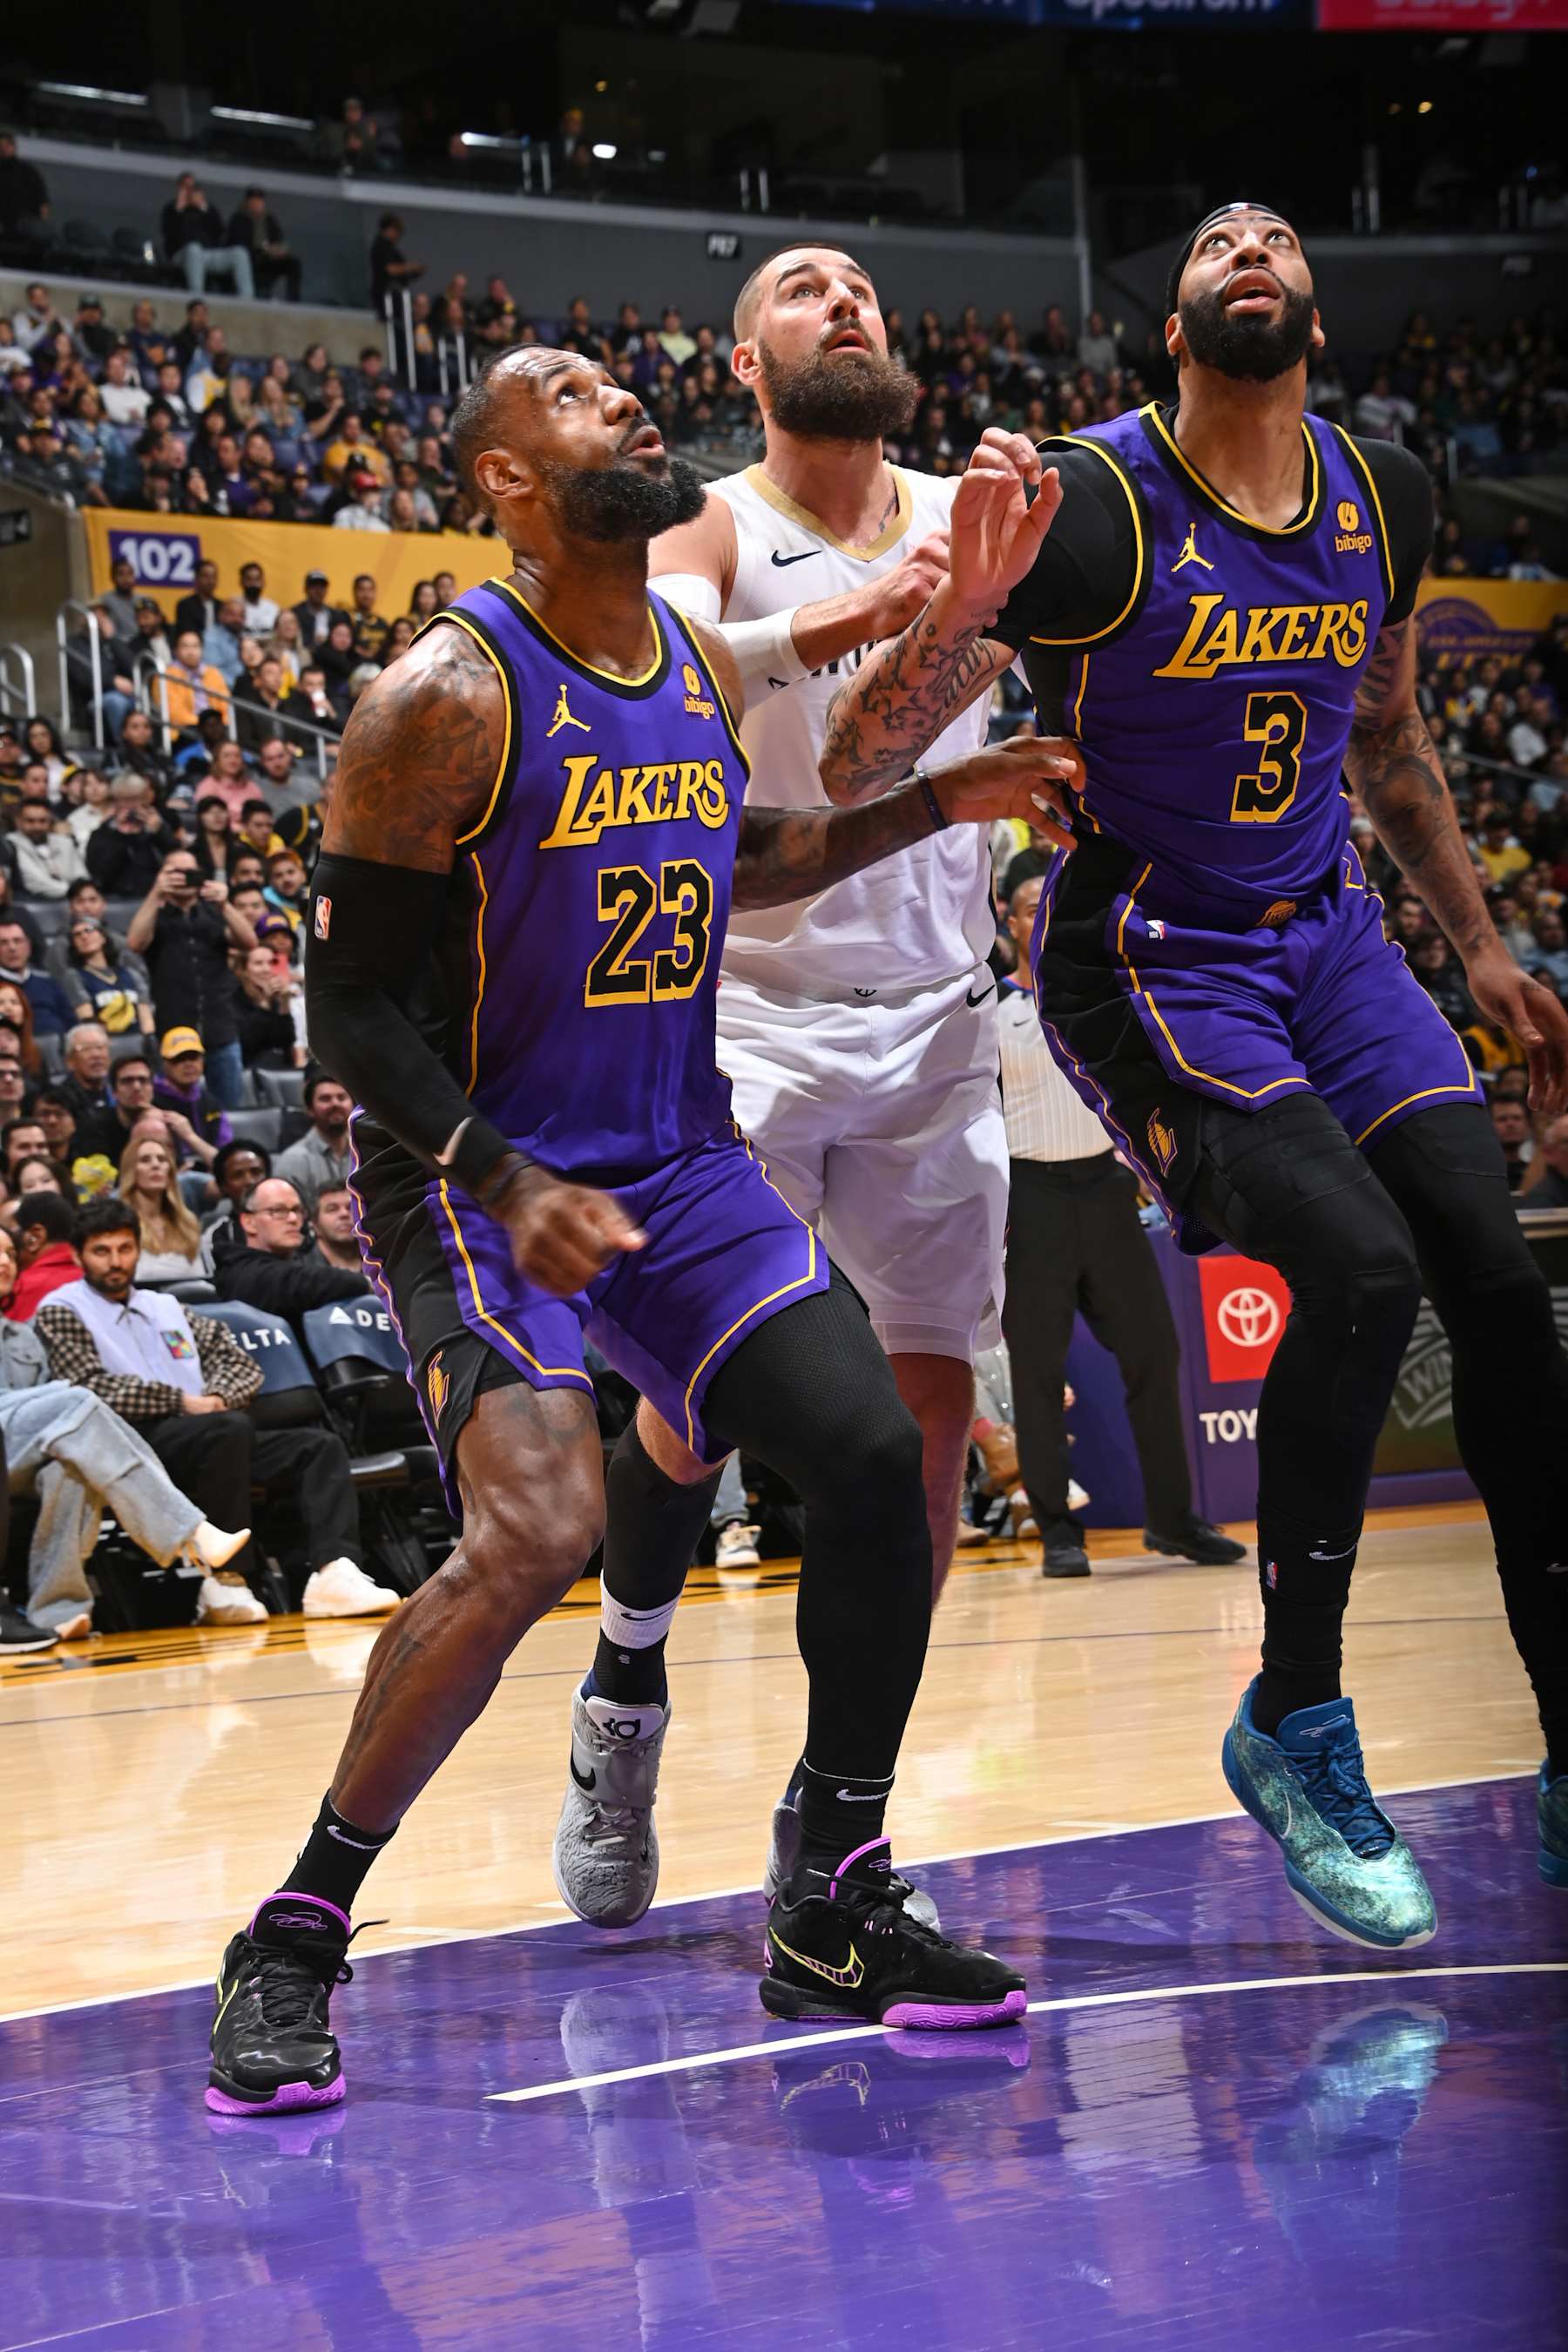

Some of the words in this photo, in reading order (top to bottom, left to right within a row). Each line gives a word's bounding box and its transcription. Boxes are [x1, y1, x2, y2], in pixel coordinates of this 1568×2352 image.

[119, 537, 195, 581] 102
[1335, 534, 1372, 554] bibigo
[1152, 593, 1369, 679] LAKERS
[683, 695, 715, 720] bibigo
[1229, 691, 1308, 823] 3
[537, 755, 730, 850] LAKERS
[584, 858, 713, 1009] 23
[1199, 1408, 1258, 1444] TOY
